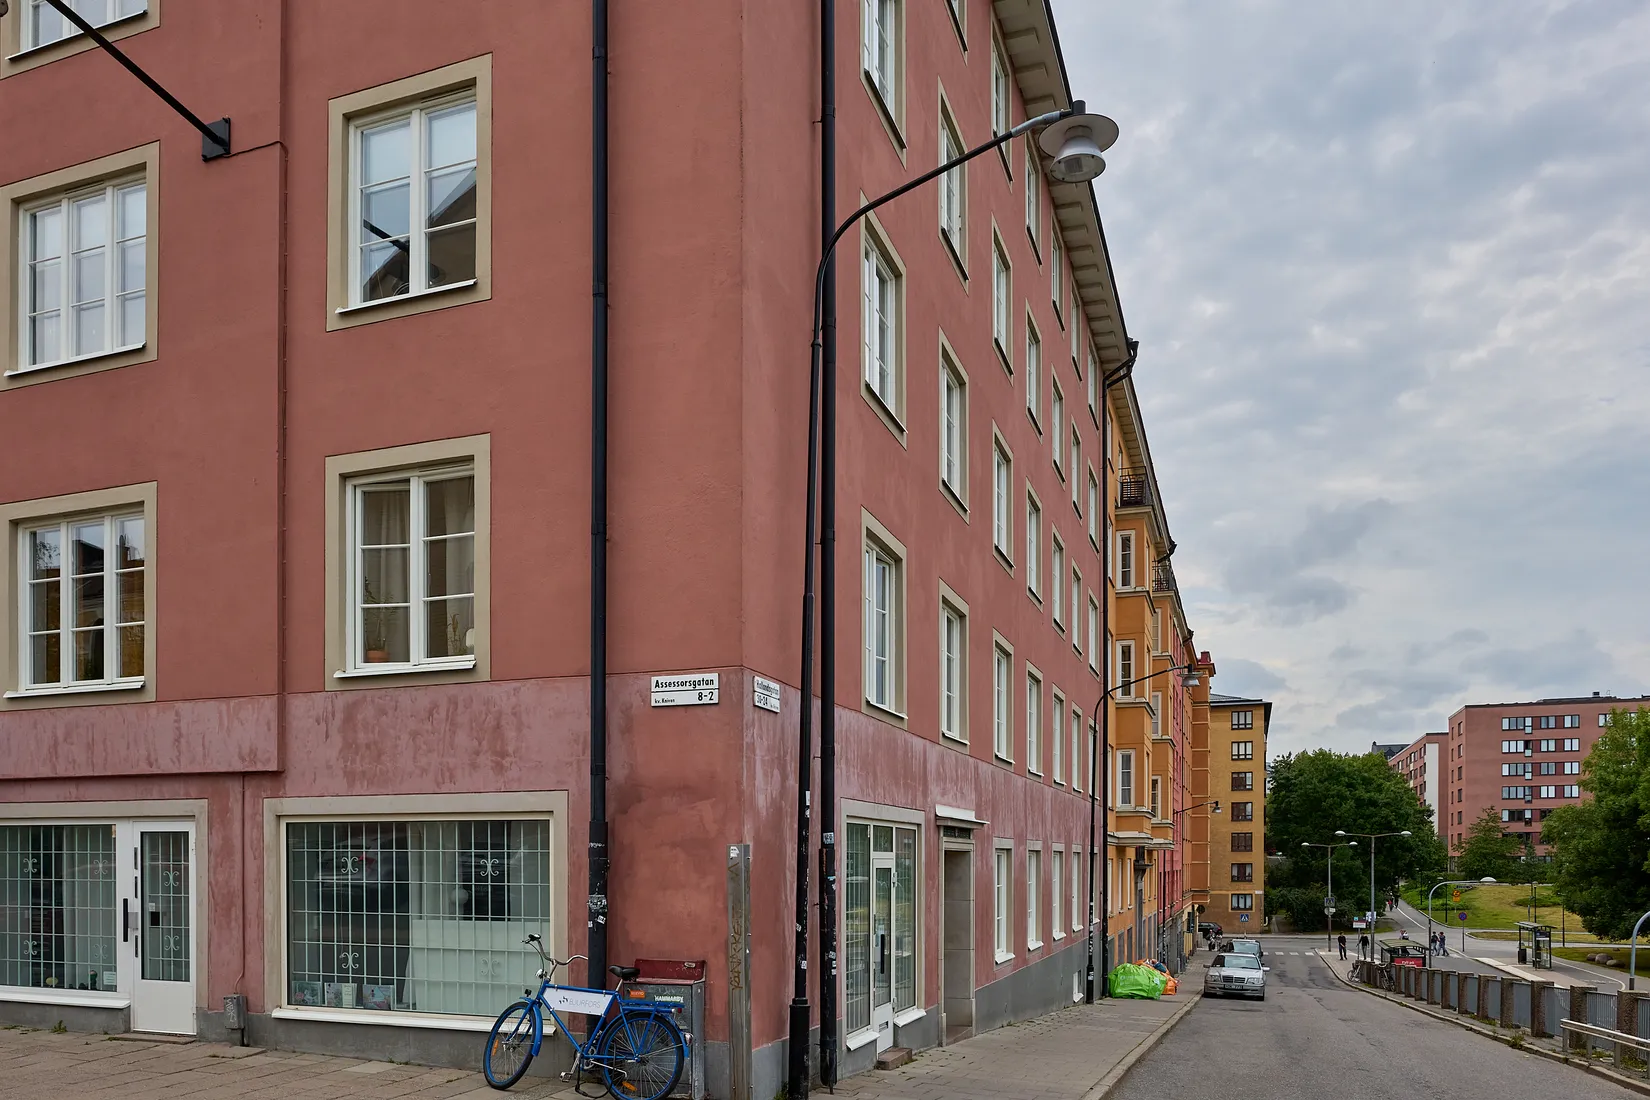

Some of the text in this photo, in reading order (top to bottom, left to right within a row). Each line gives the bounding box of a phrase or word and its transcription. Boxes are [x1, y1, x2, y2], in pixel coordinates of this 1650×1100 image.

[654, 678, 714, 689] Assessorsgatan
[697, 691, 714, 701] 8-2
[569, 998, 601, 1009] BJURFORS
